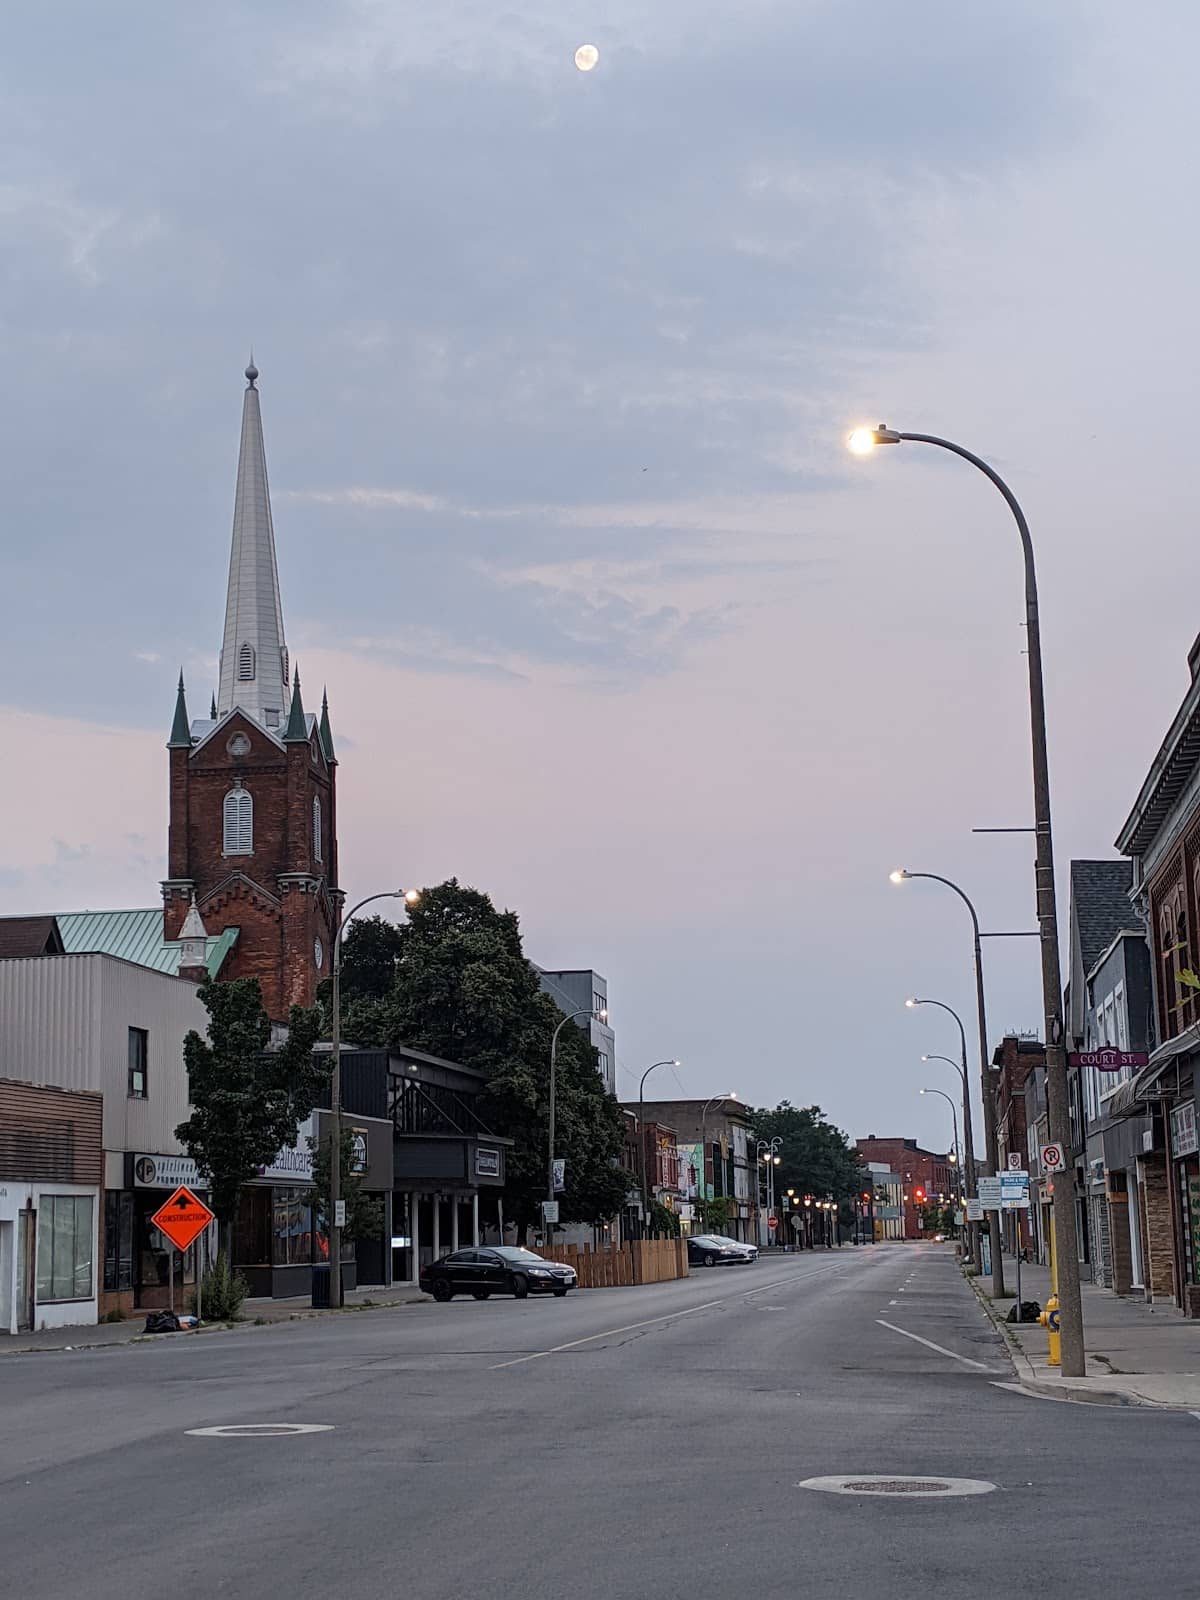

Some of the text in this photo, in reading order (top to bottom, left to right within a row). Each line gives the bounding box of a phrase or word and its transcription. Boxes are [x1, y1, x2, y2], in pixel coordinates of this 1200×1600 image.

[1080, 1054, 1137, 1064] COURT ST.
[156, 1176, 198, 1185] PROMOTIONS
[158, 1213, 207, 1223] CONSTRUCTION
